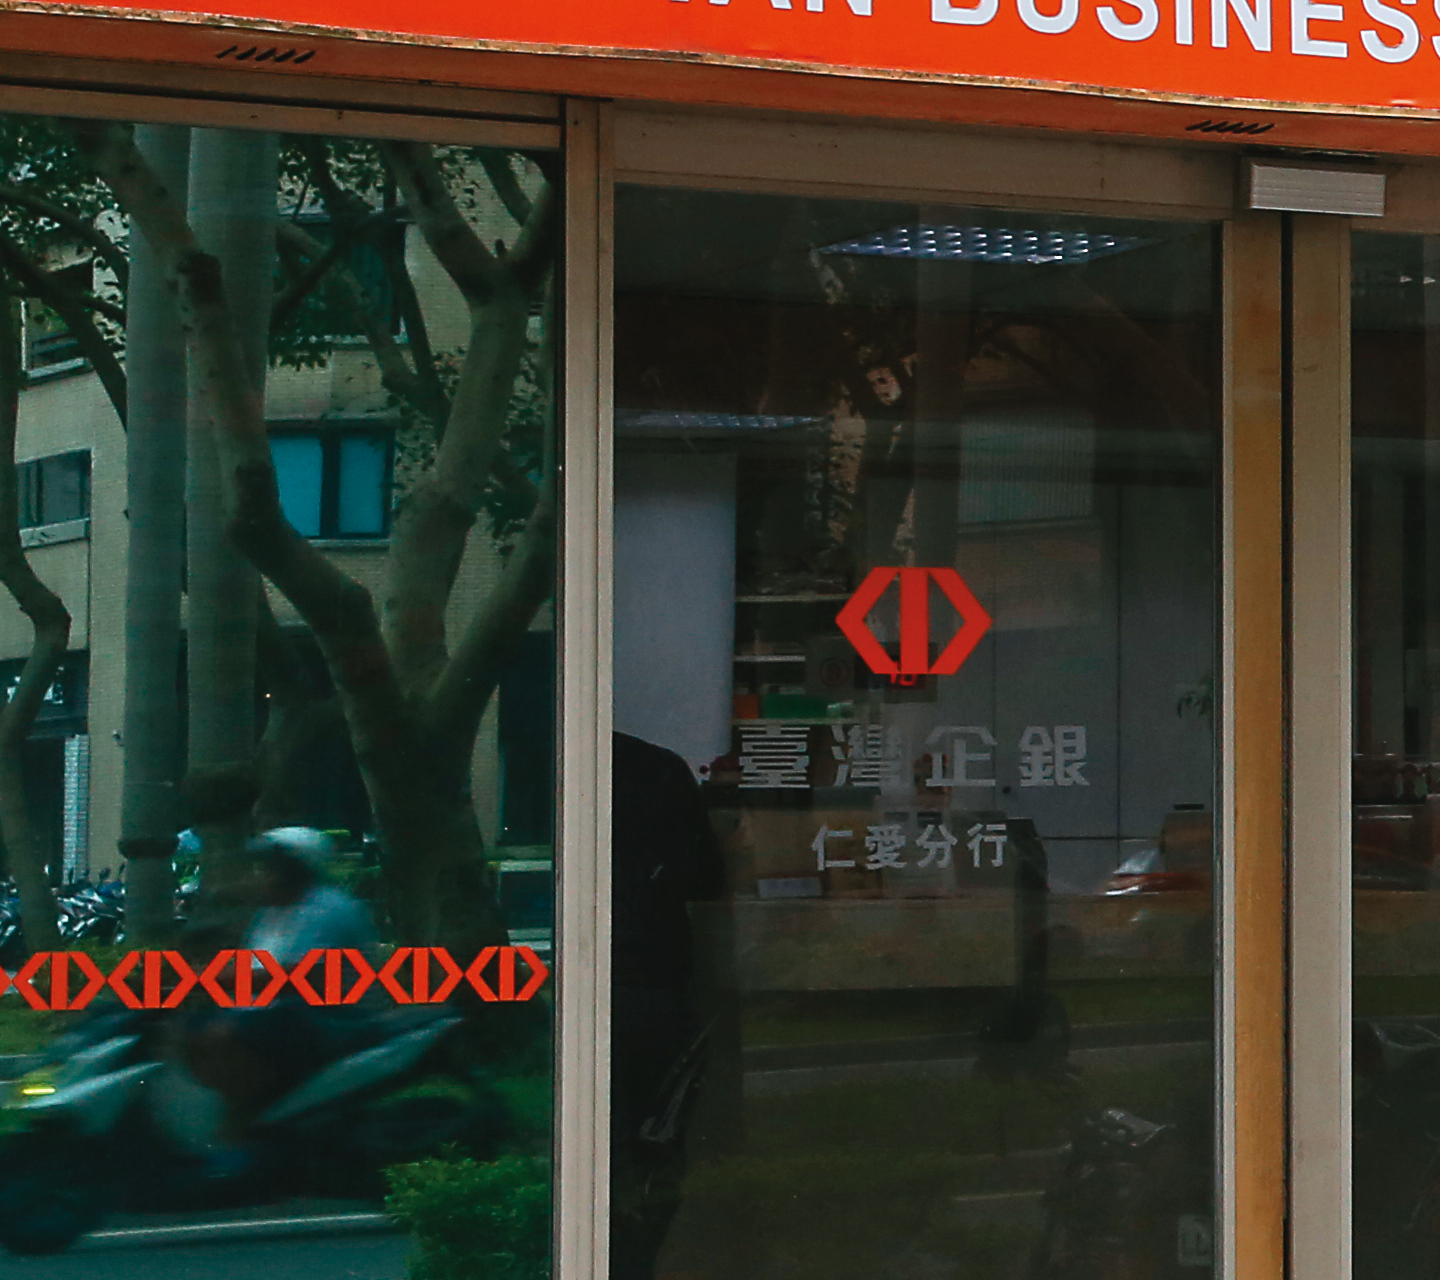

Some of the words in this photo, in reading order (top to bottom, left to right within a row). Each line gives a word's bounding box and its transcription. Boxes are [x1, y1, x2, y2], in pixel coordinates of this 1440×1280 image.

[738, 725, 1090, 789] 臺灣企銀
[811, 823, 1008, 871] 仁愛分行
